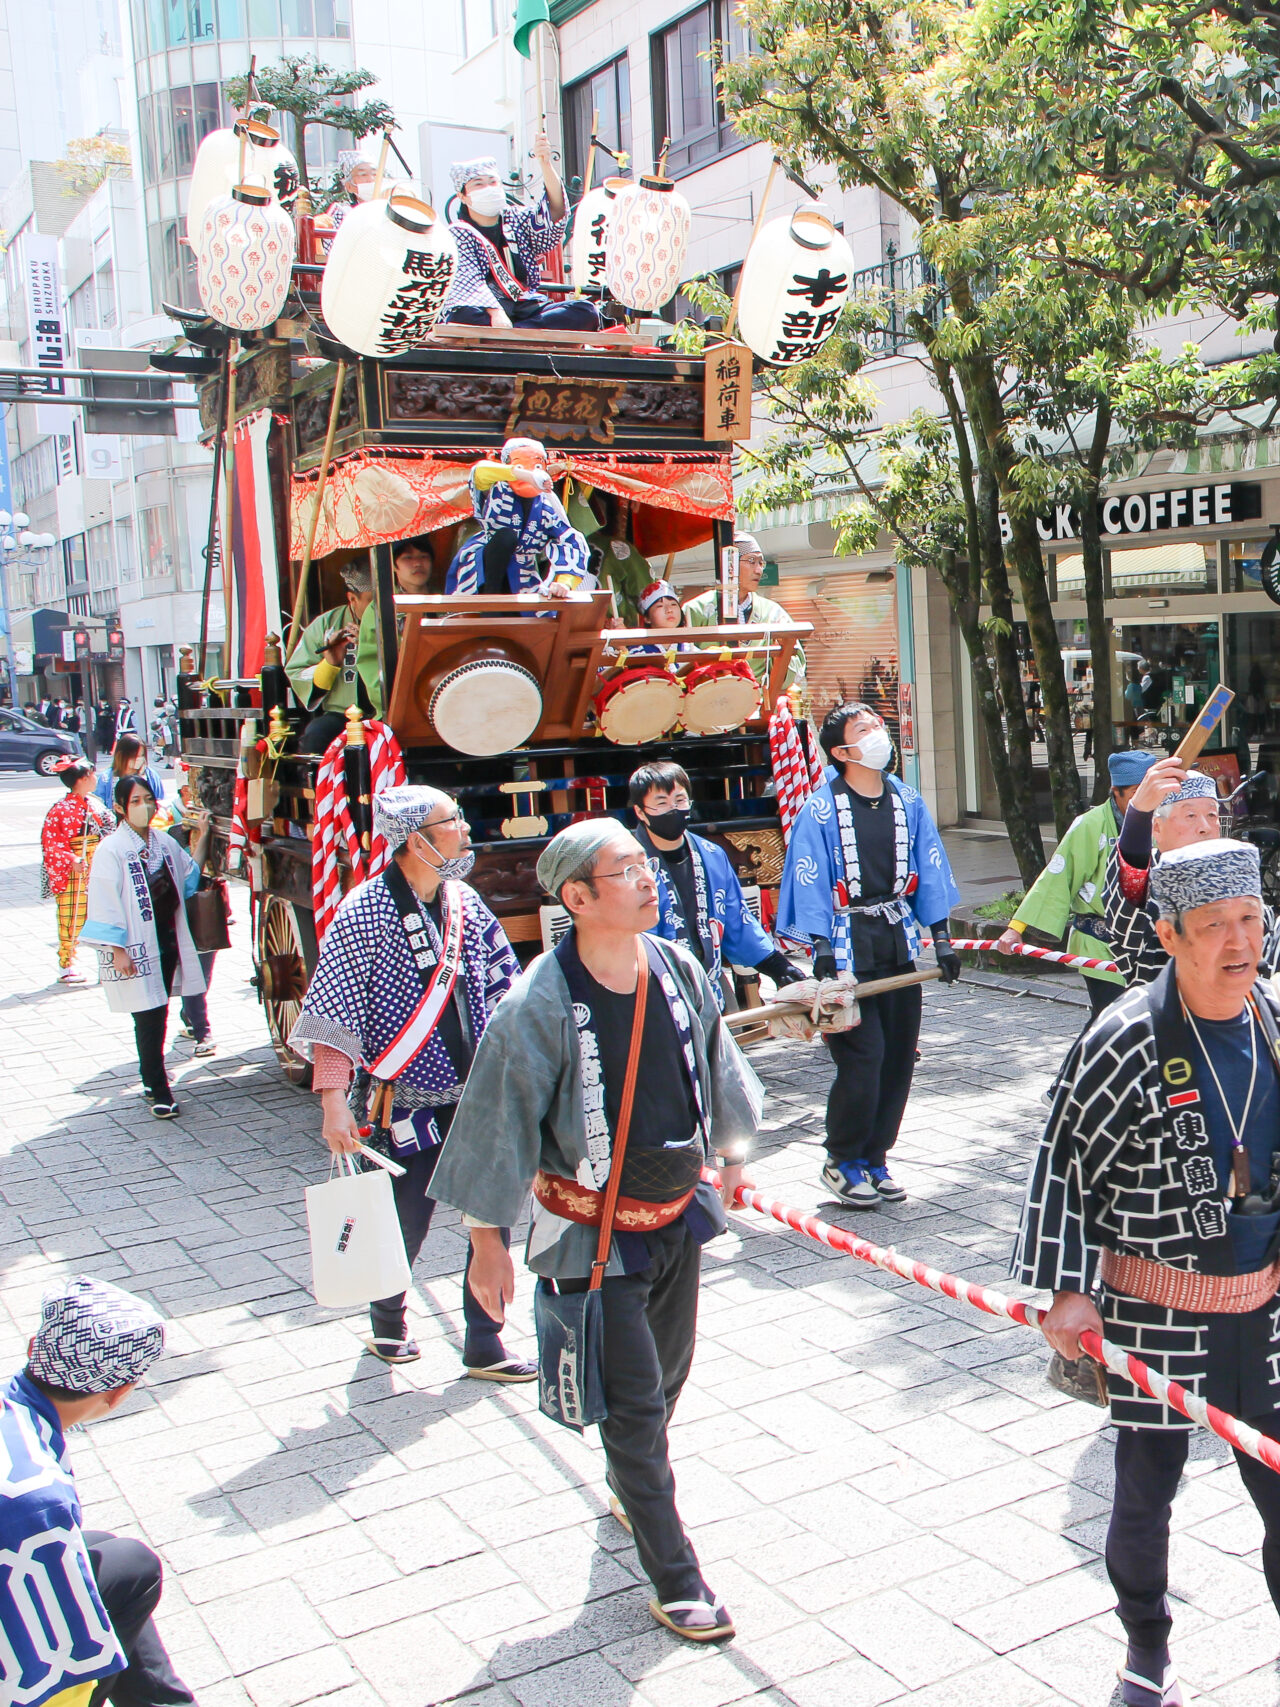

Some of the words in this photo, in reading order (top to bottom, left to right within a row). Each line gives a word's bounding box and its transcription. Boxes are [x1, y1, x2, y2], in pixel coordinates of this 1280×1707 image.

[30, 260, 42, 314] BIRUPAKU
[42, 261, 54, 315] SHIZUOKA
[715, 356, 741, 432] 稲荷車
[1102, 484, 1232, 535] COFFEE
